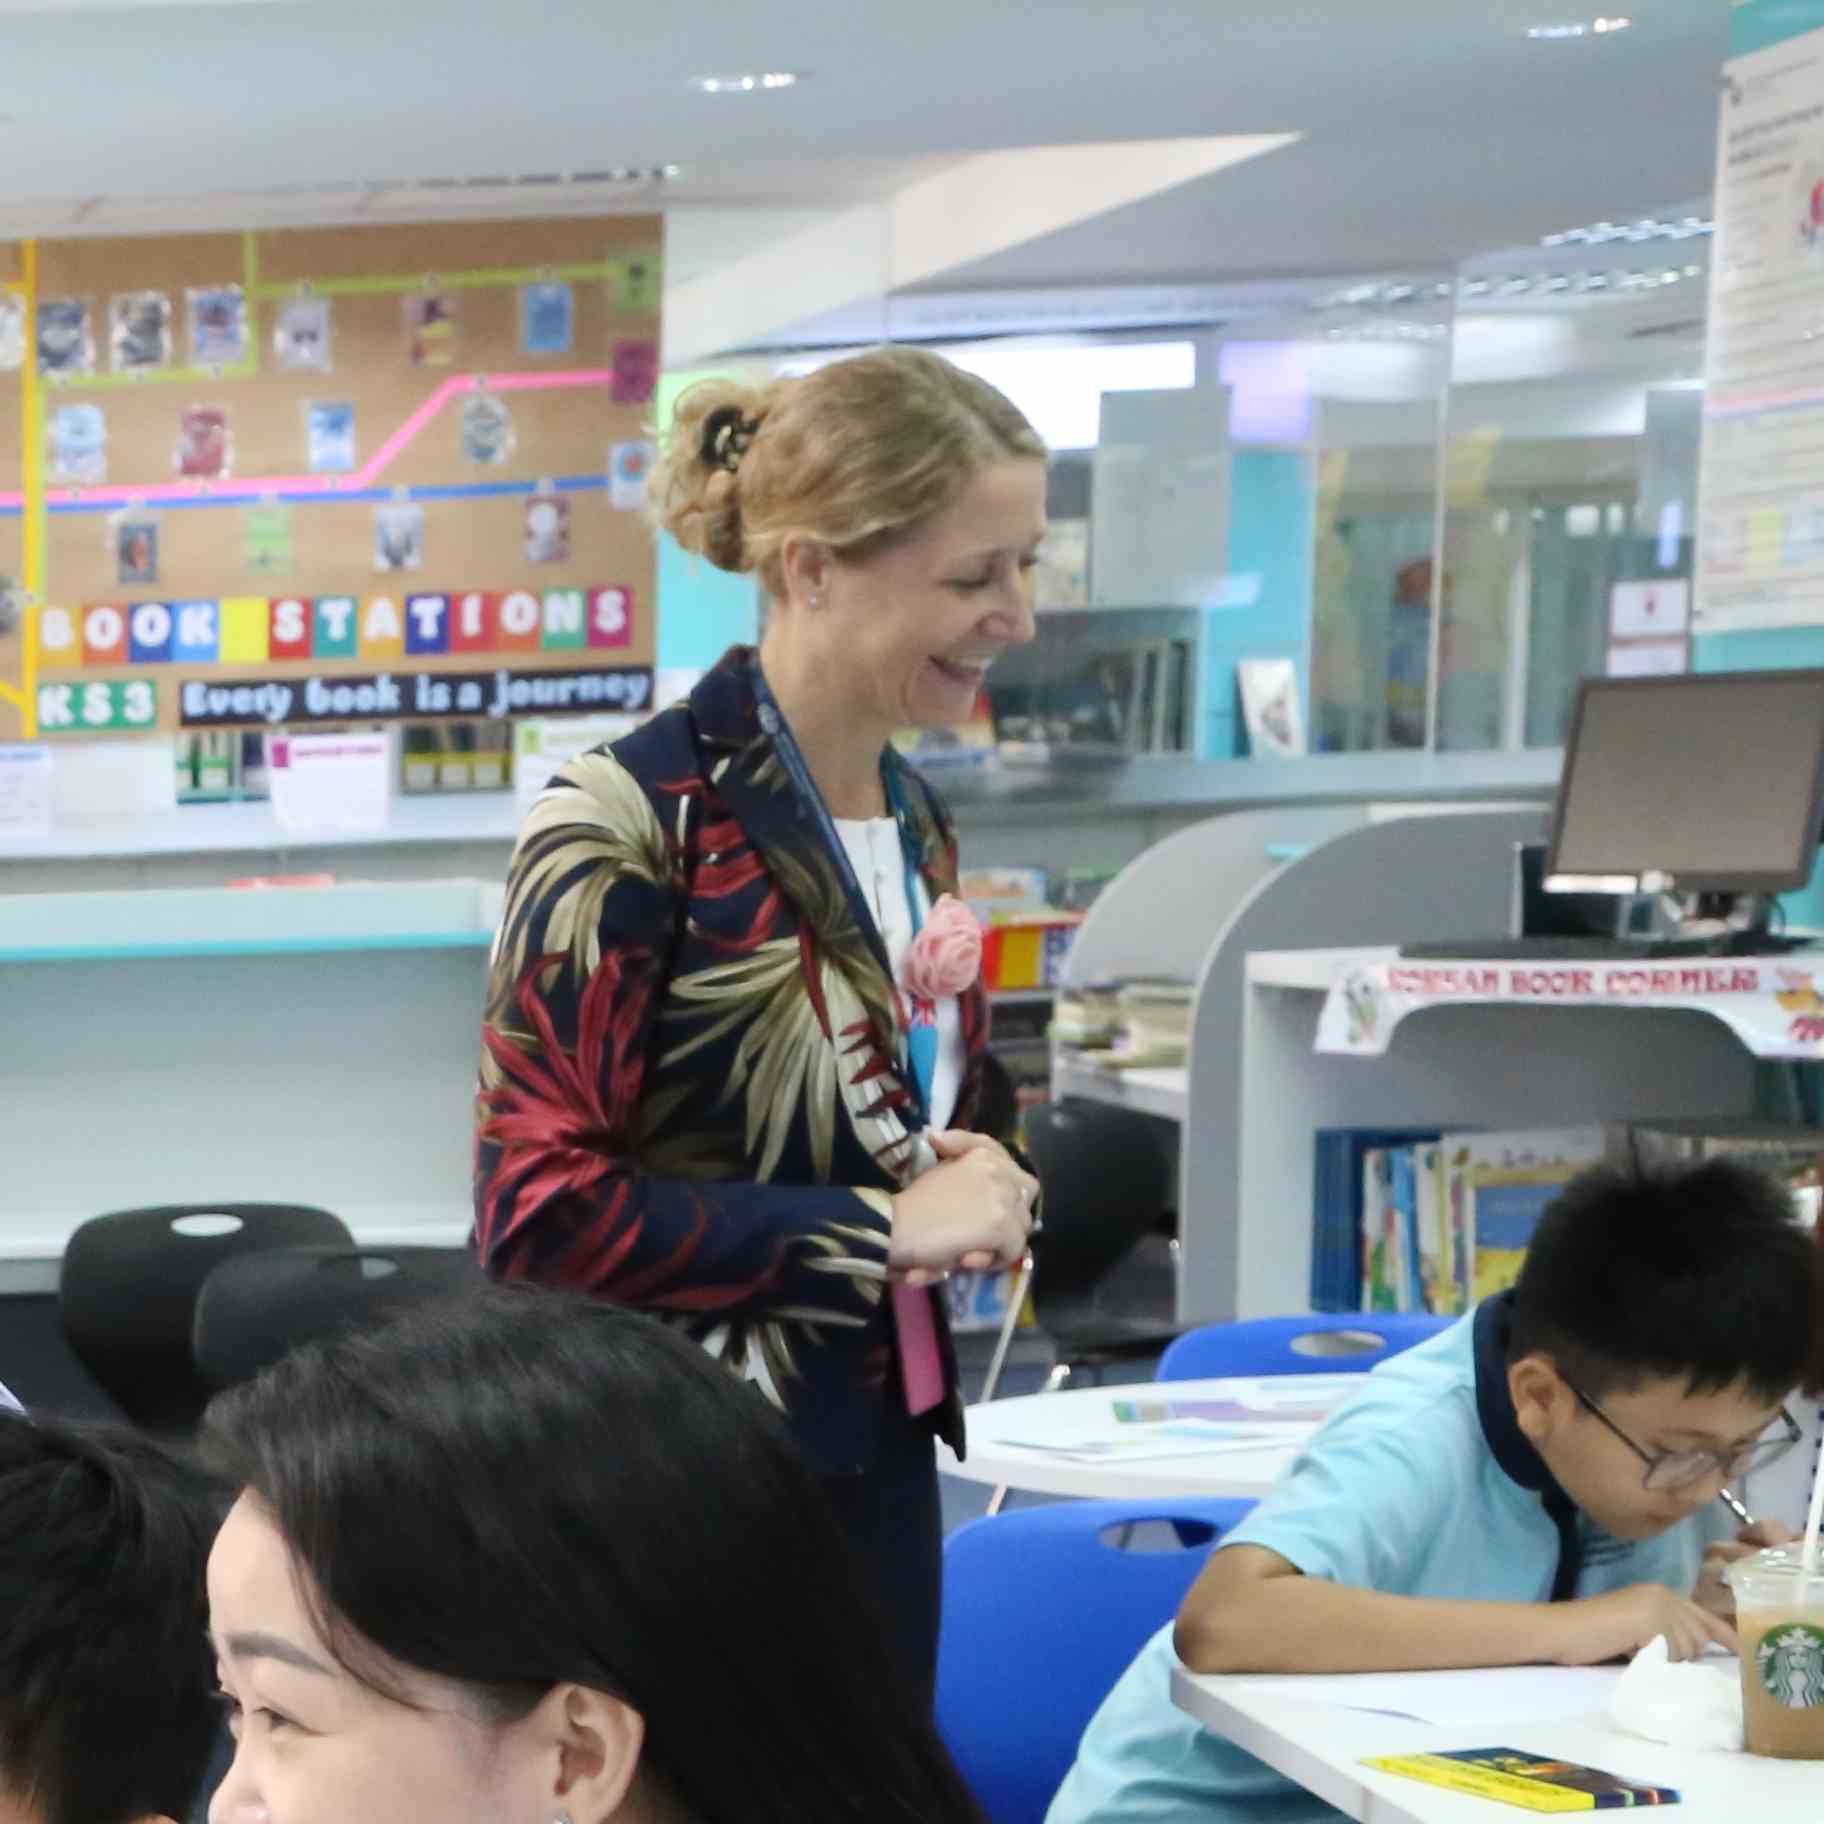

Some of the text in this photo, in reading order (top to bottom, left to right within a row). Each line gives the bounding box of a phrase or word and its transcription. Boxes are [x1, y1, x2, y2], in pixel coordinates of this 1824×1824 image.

[40, 588, 630, 651] BOOK STATIONS
[184, 681, 292, 723] Every
[305, 674, 400, 715] book
[415, 673, 450, 712] is
[458, 681, 482, 711] a
[487, 670, 649, 718] journey
[1510, 968, 1595, 995] BOOK
